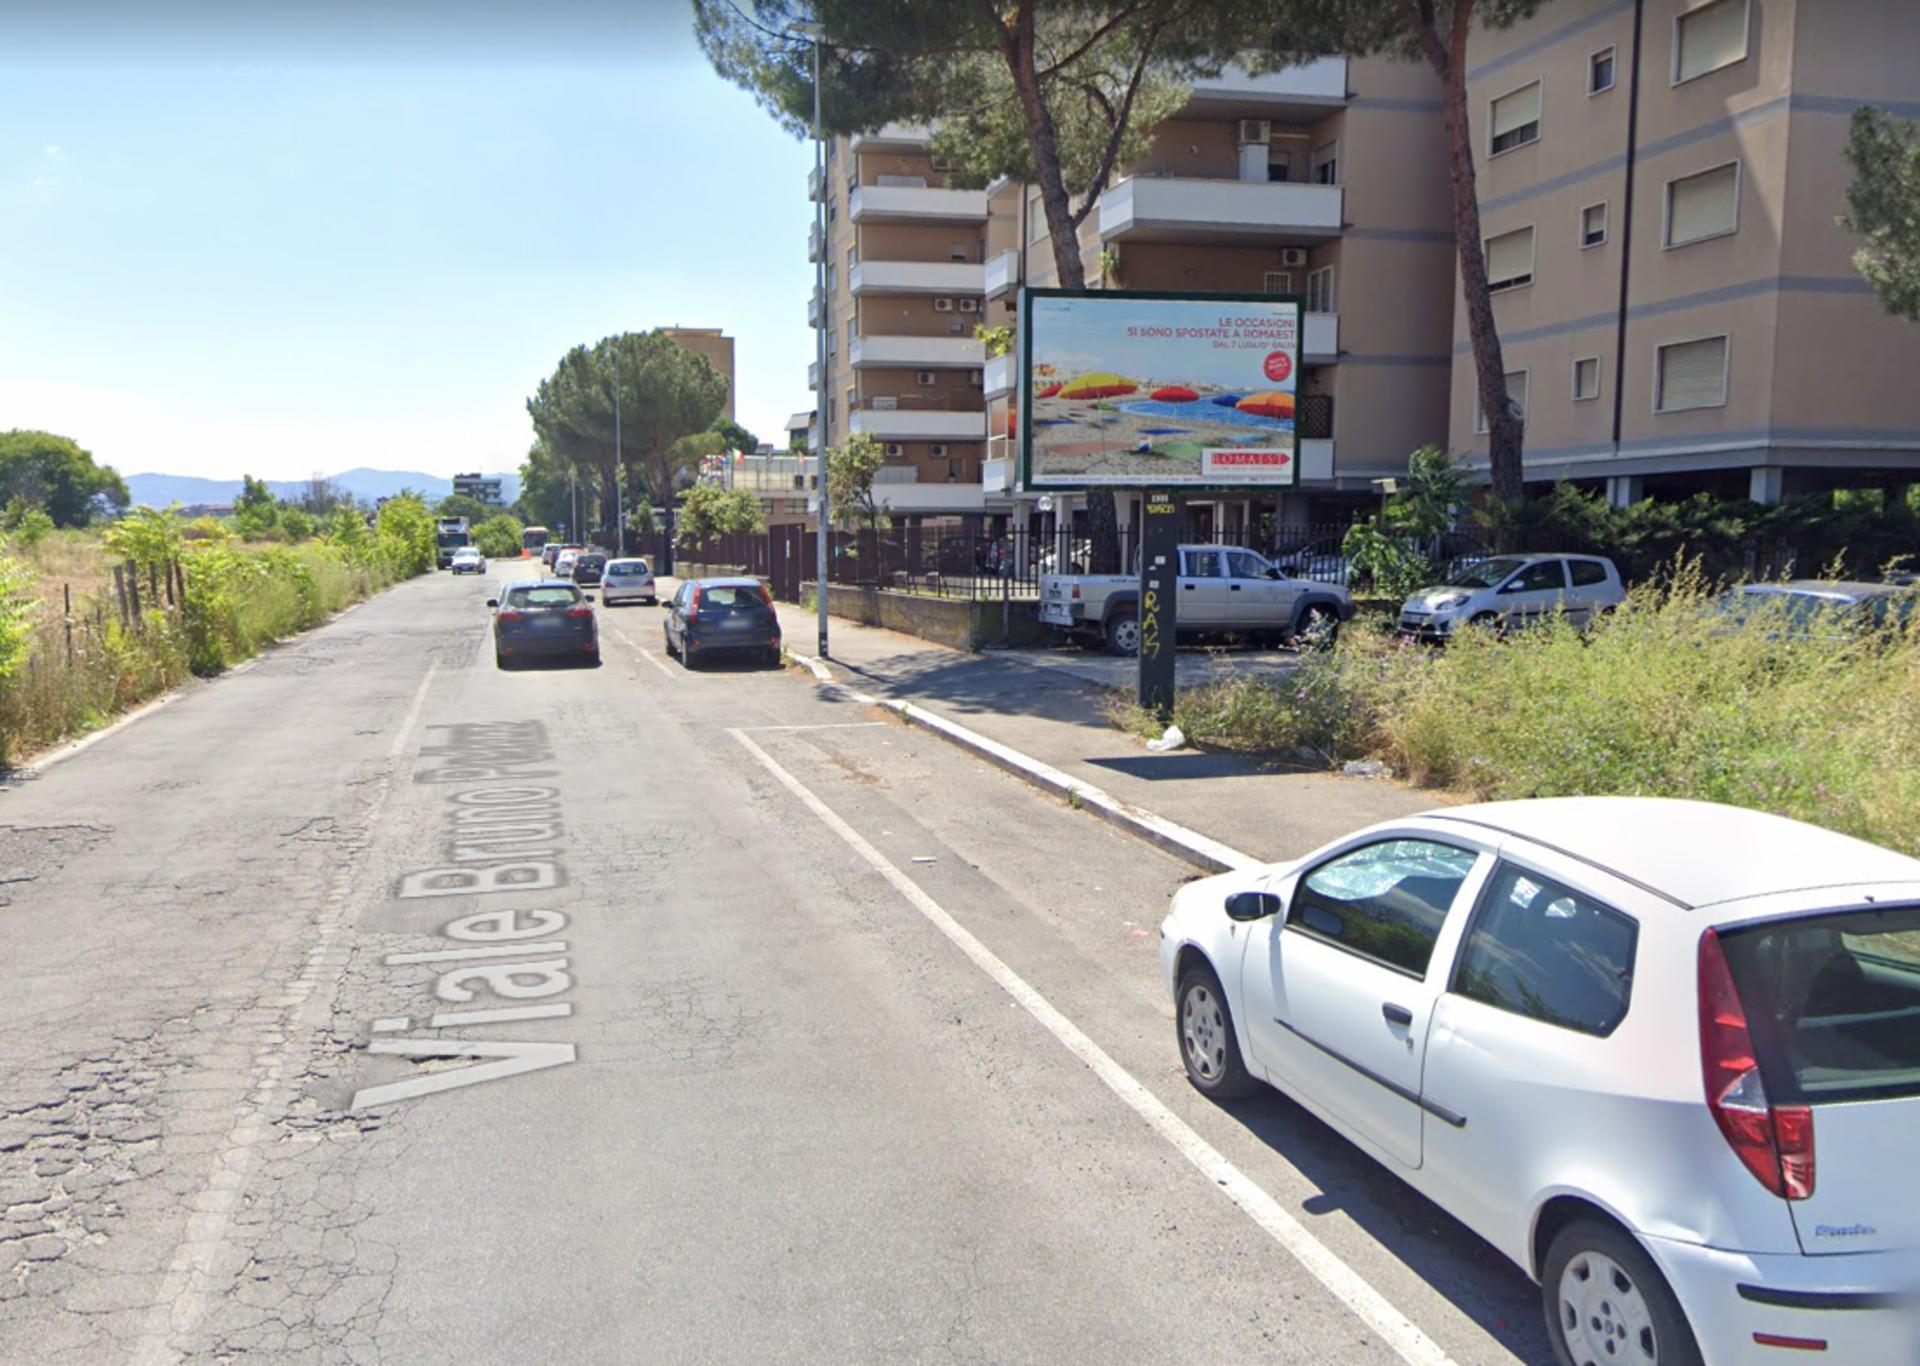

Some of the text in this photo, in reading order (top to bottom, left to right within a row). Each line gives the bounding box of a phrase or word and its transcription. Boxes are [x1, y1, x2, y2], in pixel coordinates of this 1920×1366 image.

[1219, 317, 1295, 328] LE OCCASIONI
[1127, 326, 1296, 340] SI SONO SPOSTATE A ROMAEST
